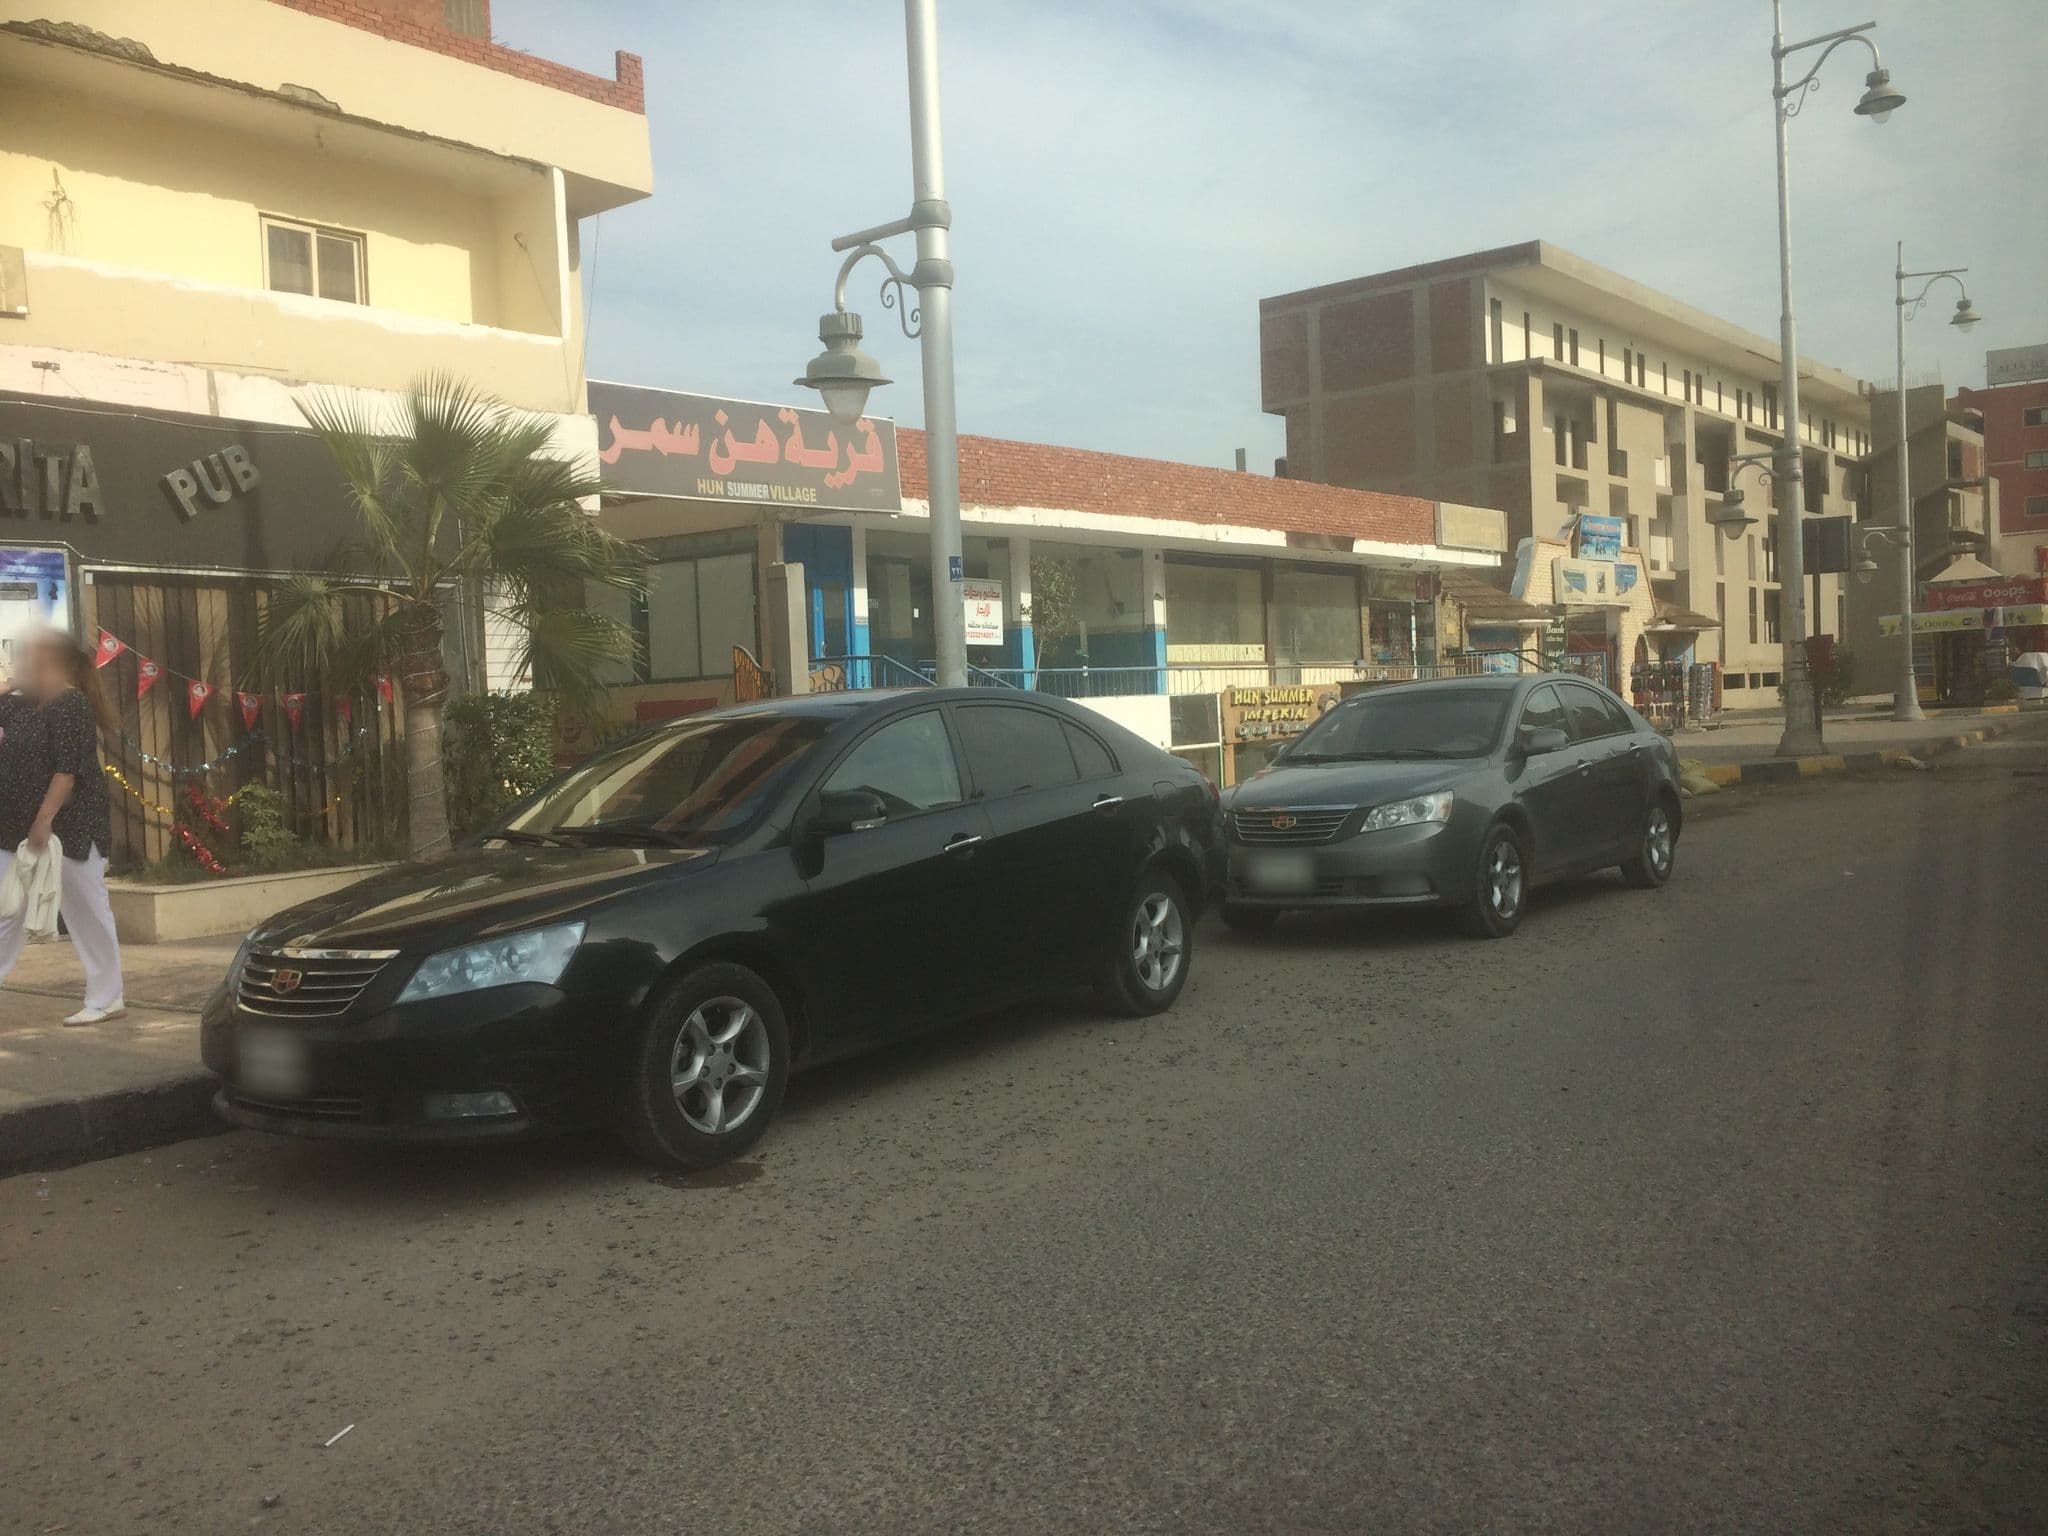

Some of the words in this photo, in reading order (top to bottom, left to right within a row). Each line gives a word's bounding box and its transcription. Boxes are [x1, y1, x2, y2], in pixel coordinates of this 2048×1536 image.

[599, 414, 700, 465] سمر
[709, 408, 779, 475] هن
[778, 407, 884, 489] قرية
[164, 444, 258, 517] PUB
[697, 478, 724, 496] HUN
[727, 482, 770, 499] SUMMER
[770, 484, 817, 502] VILLAGE
[1233, 689, 1260, 705] HUN
[1264, 688, 1314, 704] SUMMER
[1243, 708, 1310, 722] IMPERIAL
